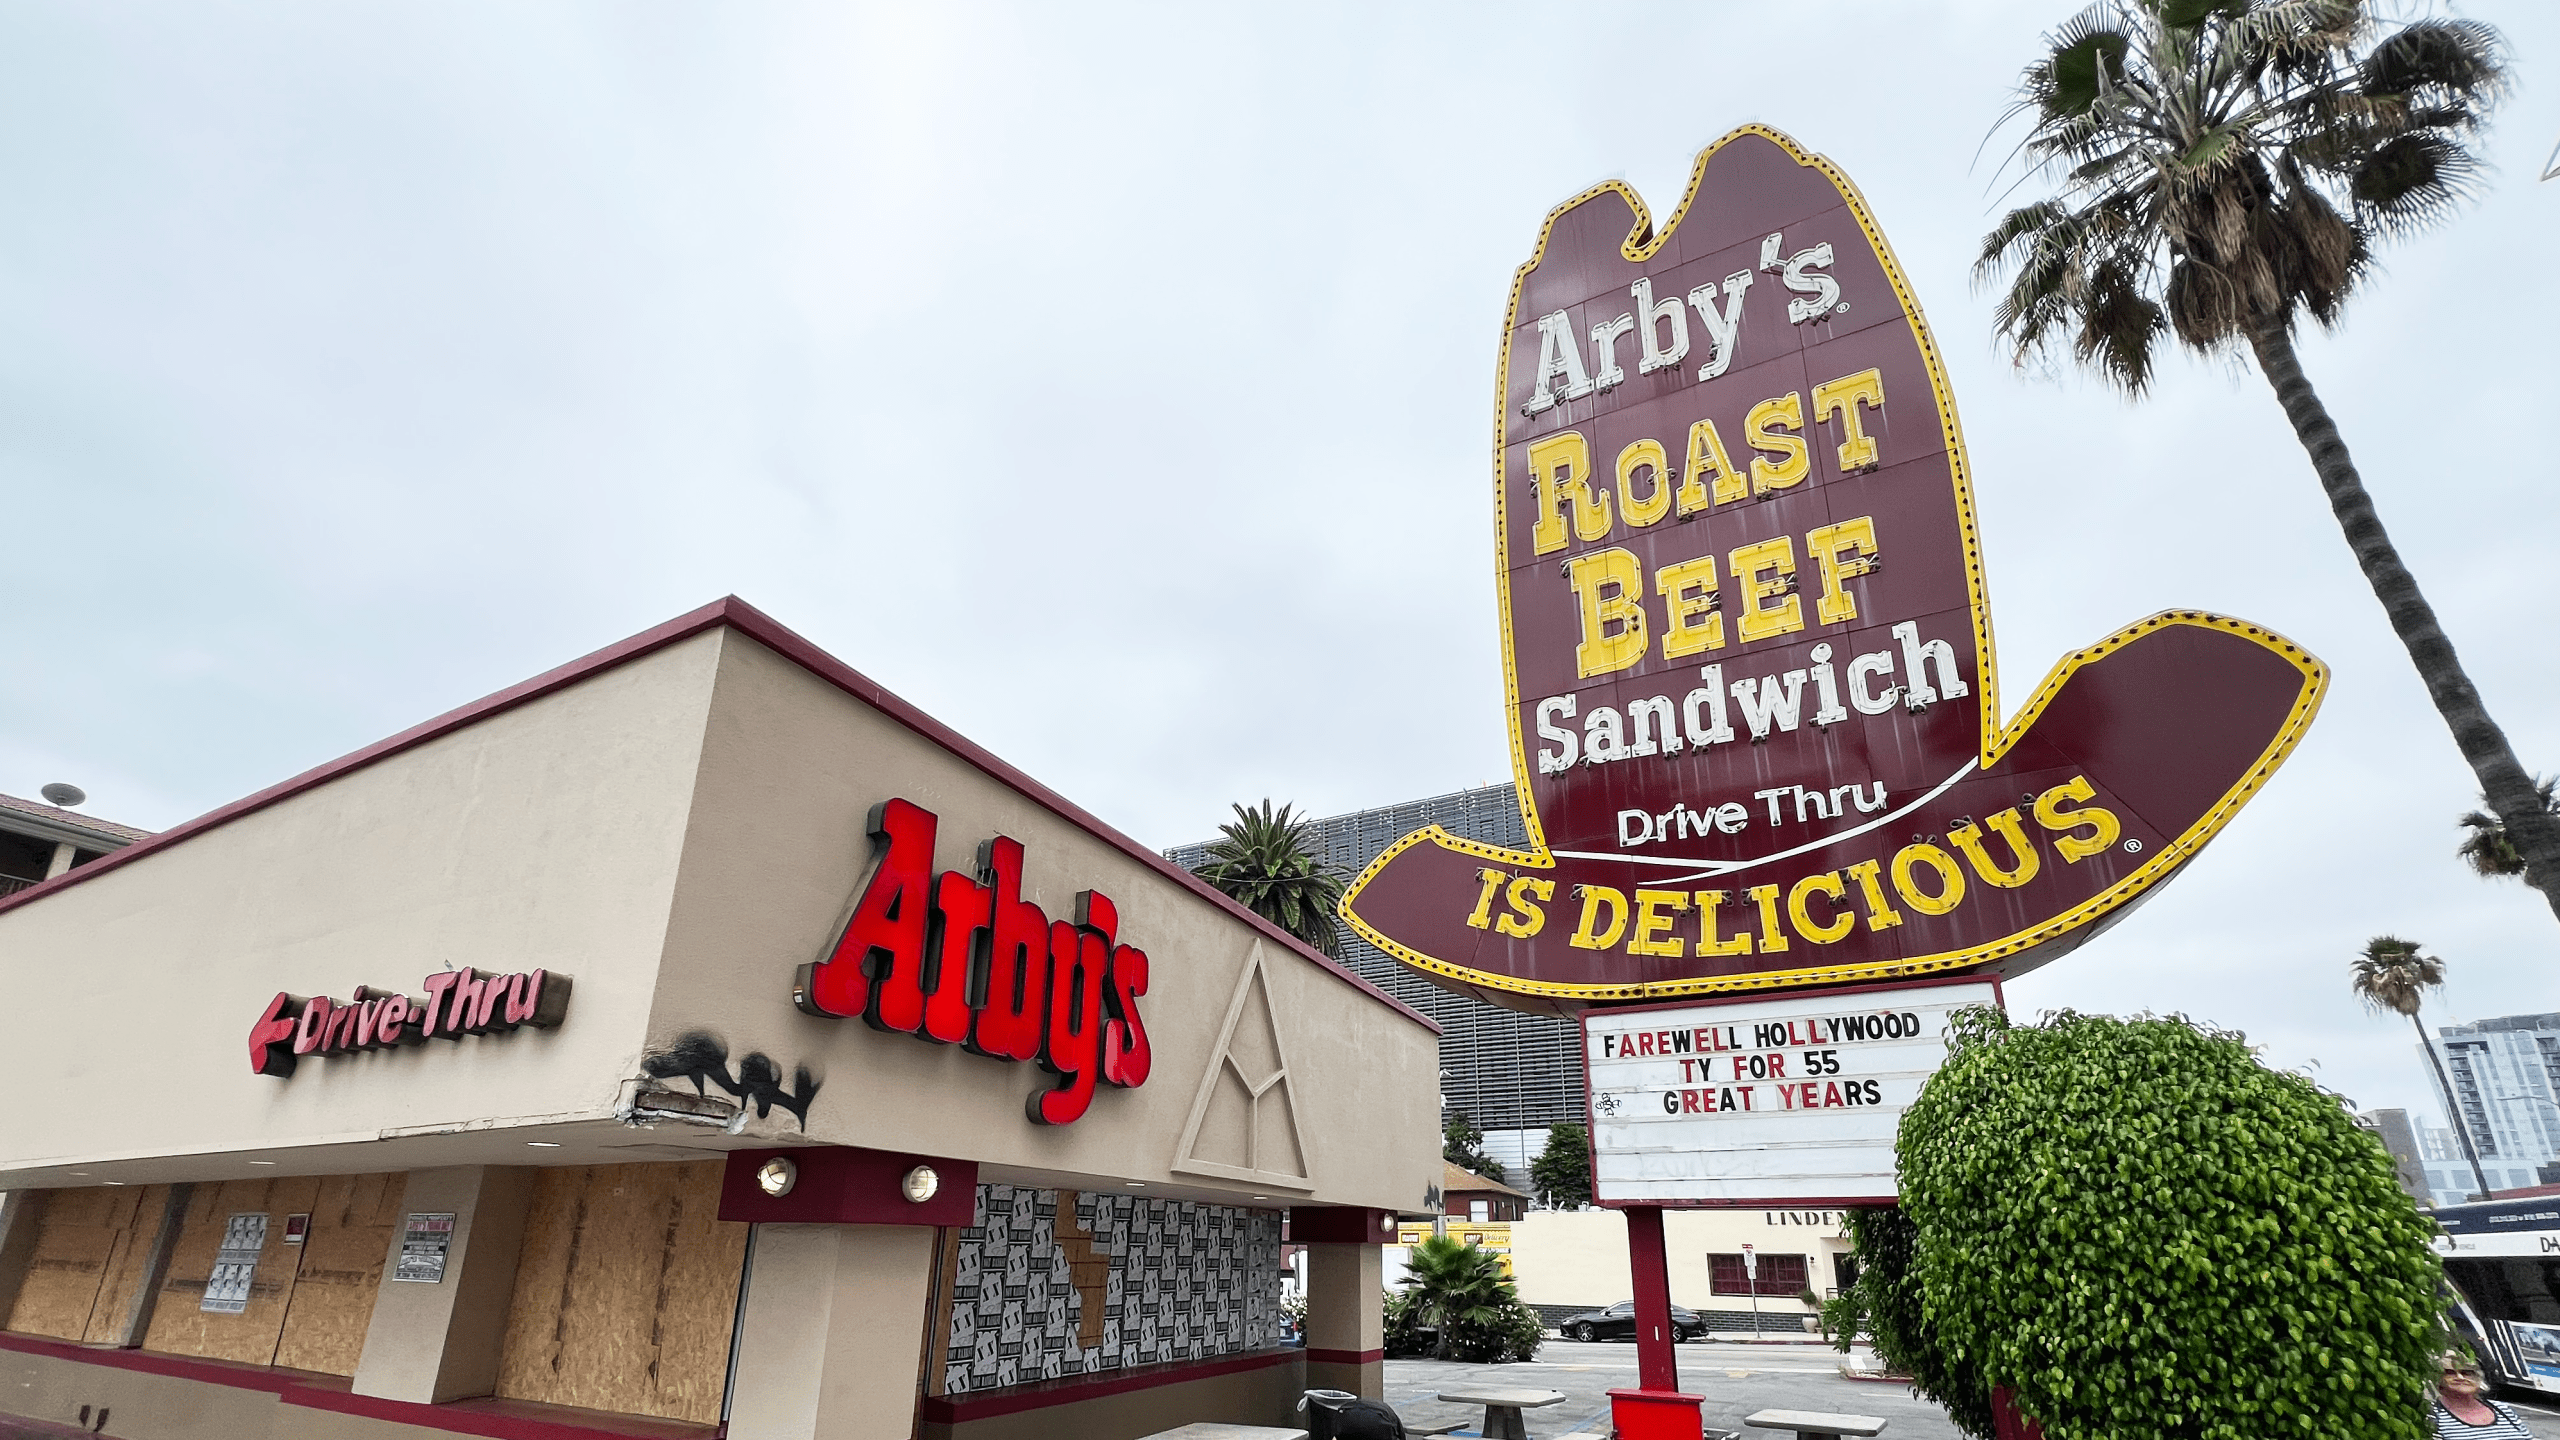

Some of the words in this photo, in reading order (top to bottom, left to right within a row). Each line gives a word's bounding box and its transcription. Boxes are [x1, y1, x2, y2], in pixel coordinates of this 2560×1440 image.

[1523, 233, 1841, 416] Arby's
[1528, 367, 1885, 556] ROAST
[1567, 516, 1880, 679] BEEF
[1535, 619, 1969, 775] Sandwich
[1467, 868, 1555, 939] IS
[1570, 775, 2121, 957] DELICIOUS
[1617, 802, 1748, 847] Drive
[1754, 781, 1888, 826] Thru
[804, 797, 1152, 1126] Arby's
[1604, 1024, 1743, 1058] FAREWELL
[1754, 1012, 1921, 1048] HOLLYWOOD
[1663, 1086, 1755, 1114] GREAT
[1777, 1079, 1882, 1110] YEARS
[1679, 1057, 1712, 1083] TY
[1733, 1053, 1786, 1081] FOR
[1804, 1049, 1840, 1076] 55
